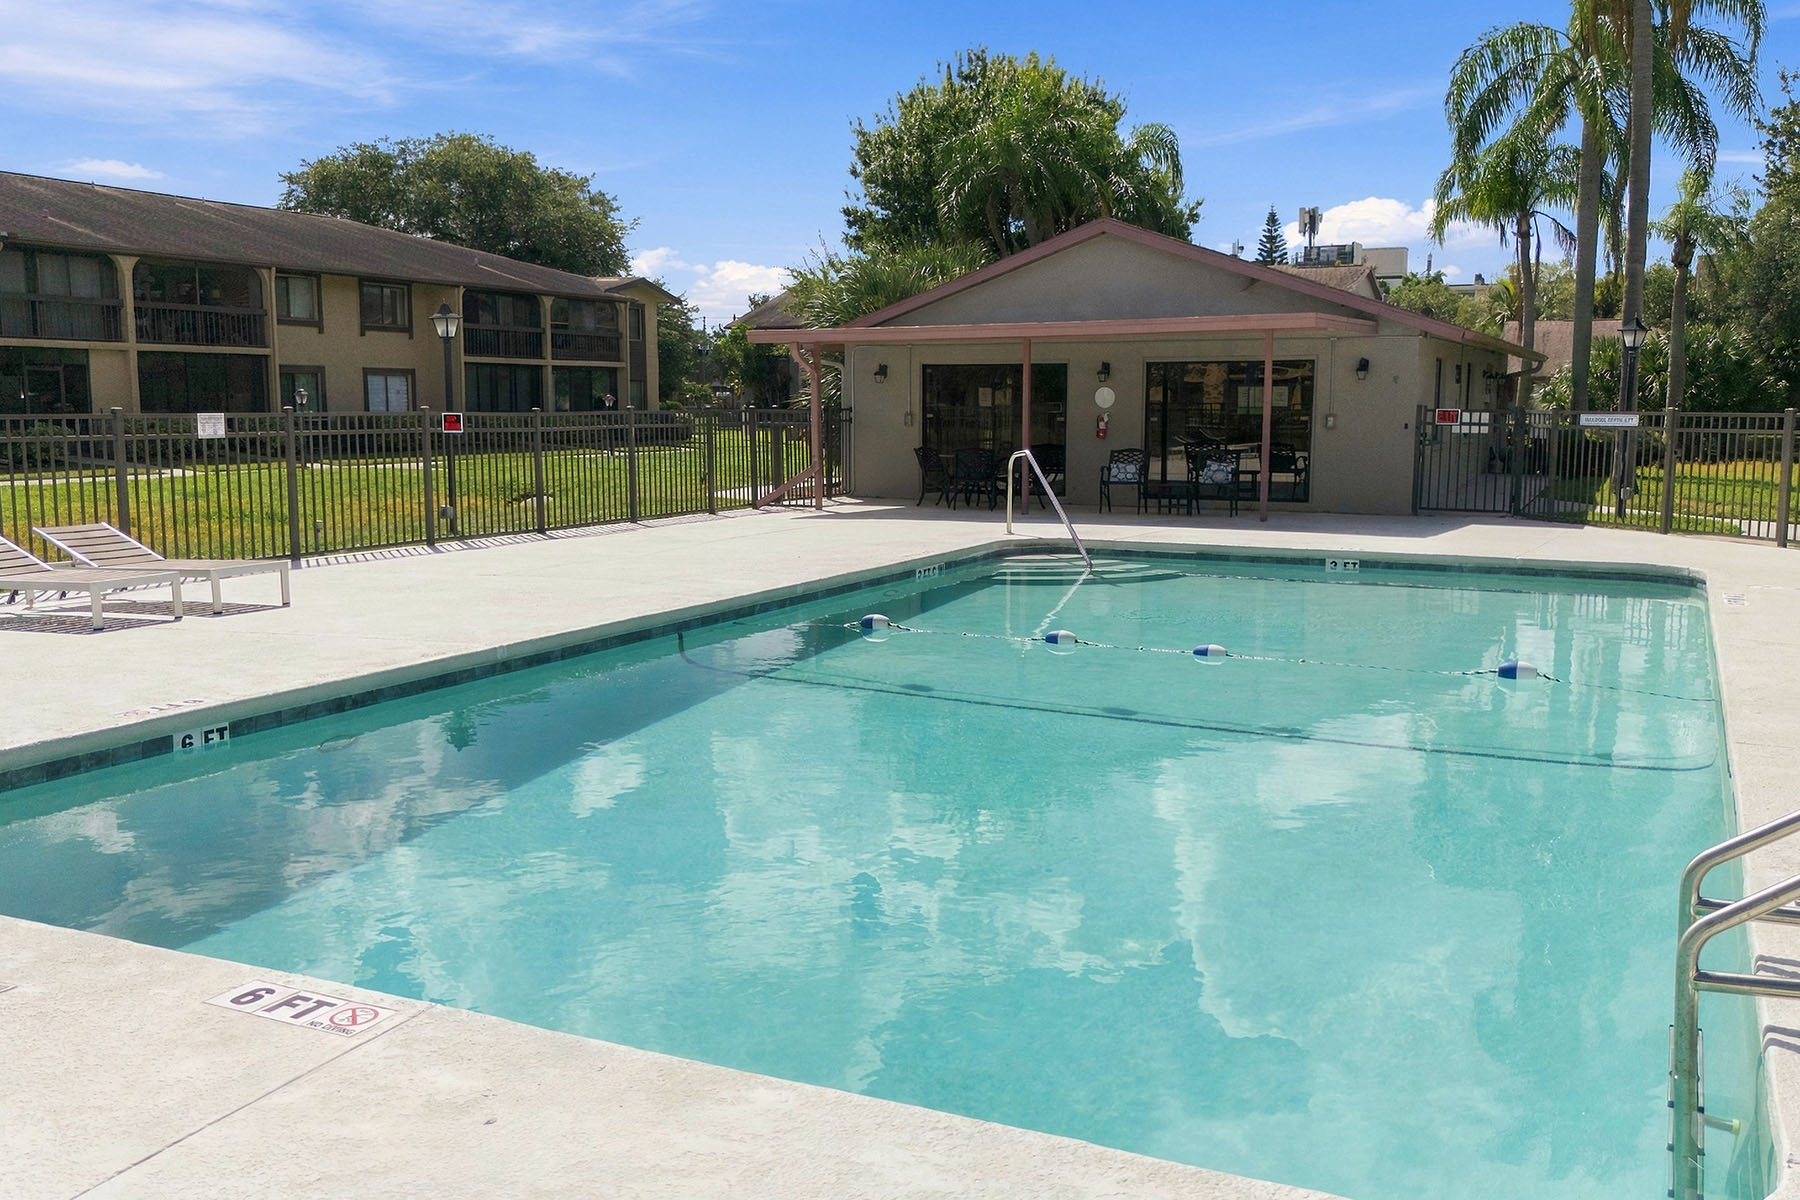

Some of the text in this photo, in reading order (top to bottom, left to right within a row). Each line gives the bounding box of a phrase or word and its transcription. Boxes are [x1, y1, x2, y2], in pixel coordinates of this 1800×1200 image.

[181, 726, 228, 749] 6 FT
[230, 987, 338, 1019] 6 FT
[308, 1020, 356, 1035] NO DIVING
